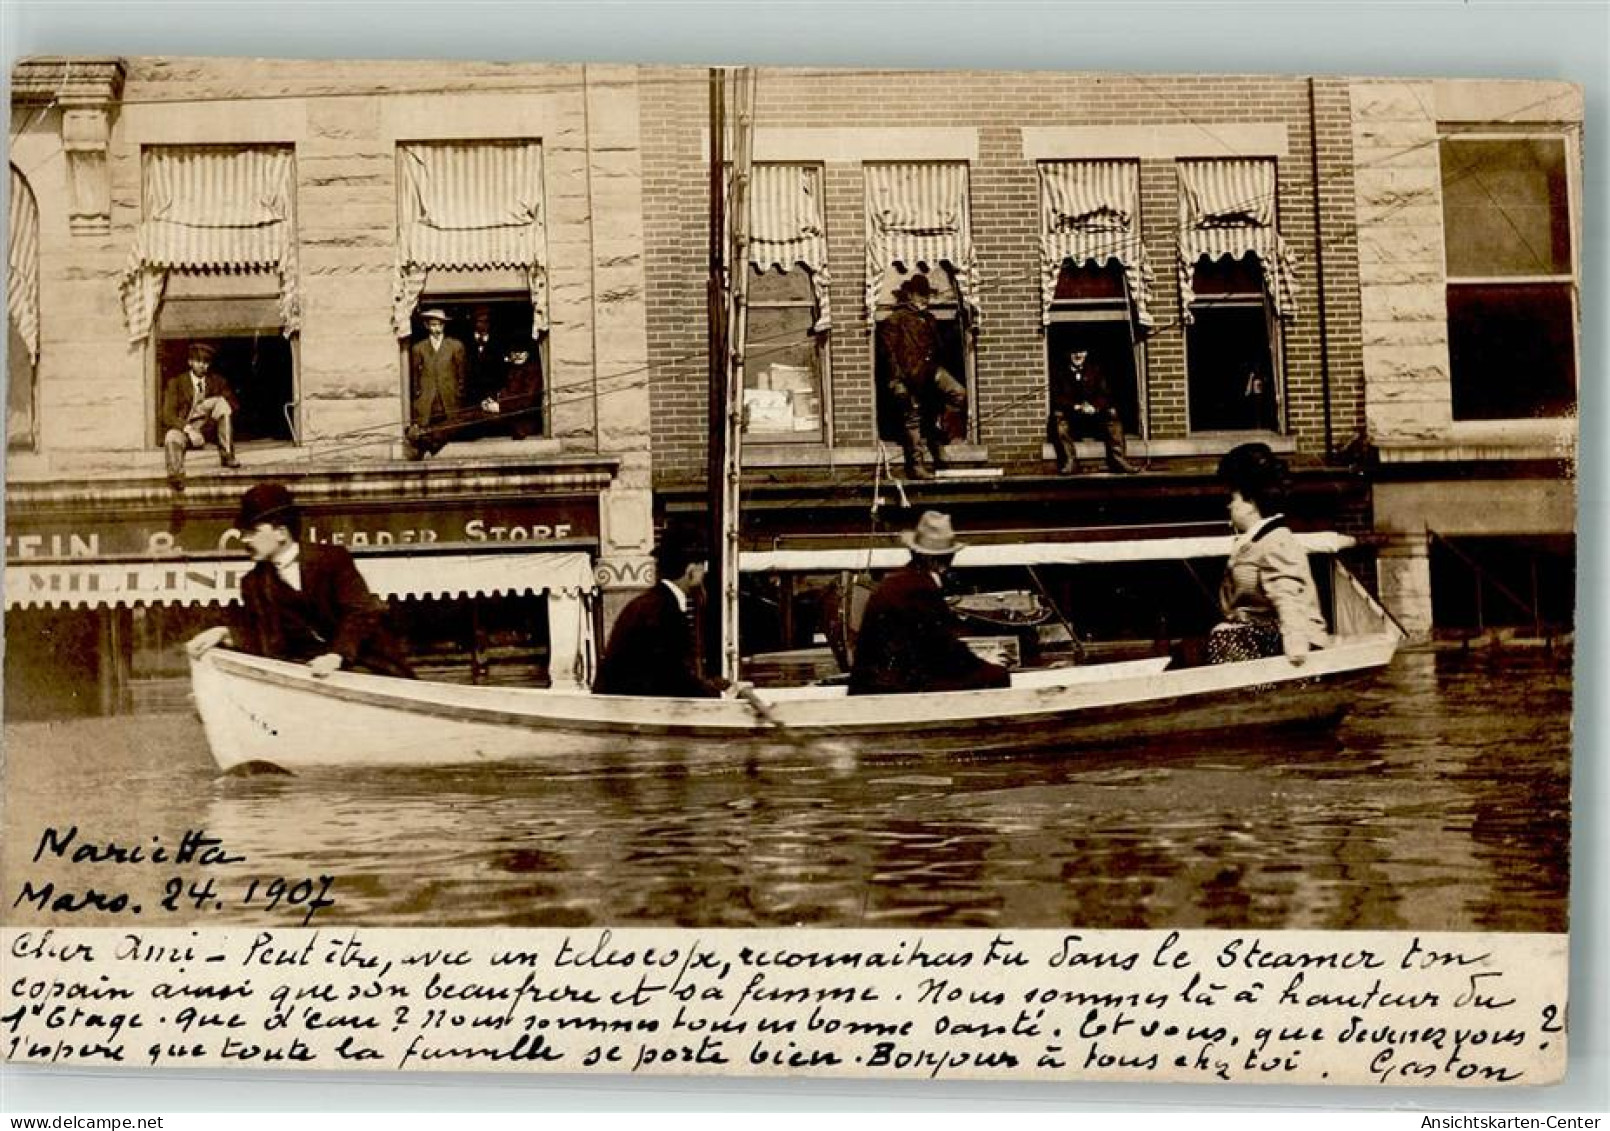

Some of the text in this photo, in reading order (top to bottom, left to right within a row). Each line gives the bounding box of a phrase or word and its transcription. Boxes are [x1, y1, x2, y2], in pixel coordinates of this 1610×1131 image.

[5, 533, 98, 558] EIN
[148, 531, 182, 556] &
[465, 519, 571, 543] STORE
[162, 876, 222, 911] 24.
[244, 874, 335, 926] 1907
[11, 930, 95, 962] Cher
[115, 932, 197, 962] Ami
[401, 950, 472, 966] avec
[490, 949, 537, 966] un
[1049, 936, 1138, 969] dans
[1153, 932, 1191, 969] le
[1217, 939, 1385, 968] Steamer
[1401, 938, 1490, 968] ton
[11, 976, 133, 1003] copain
[151, 968, 253, 1001] ainsi
[270, 984, 338, 1011] que
[348, 978, 411, 1000] son
[610, 976, 666, 1005] et
[674, 981, 723, 1001] sa
[918, 978, 1005, 1005] Nous
[1025, 987, 1168, 1009] sommes
[1278, 972, 1440, 1009] hauteur
[1455, 972, 1516, 1008] du
[174, 1009, 246, 1032] Que
[421, 1009, 513, 1029] Nous
[524, 1014, 660, 1032] sommes
[673, 1007, 746, 1032] tous
[807, 1007, 914, 1035] bonne
[1080, 1008, 1134, 1038] Et
[1254, 1027, 1325, 1051] que
[1338, 1017, 1444, 1049] devenez
[149, 1043, 207, 1065] que
[220, 1036, 317, 1061] toute
[336, 1036, 384, 1059] la
[399, 1035, 563, 1069] famille
[583, 1047, 623, 1066] se
[632, 1036, 729, 1071] porte
[866, 1042, 1019, 1078] Bonjour
[1083, 1043, 1157, 1068] tous
[1174, 1042, 1230, 1080] chez
[1370, 1048, 1524, 1083] Gaston
